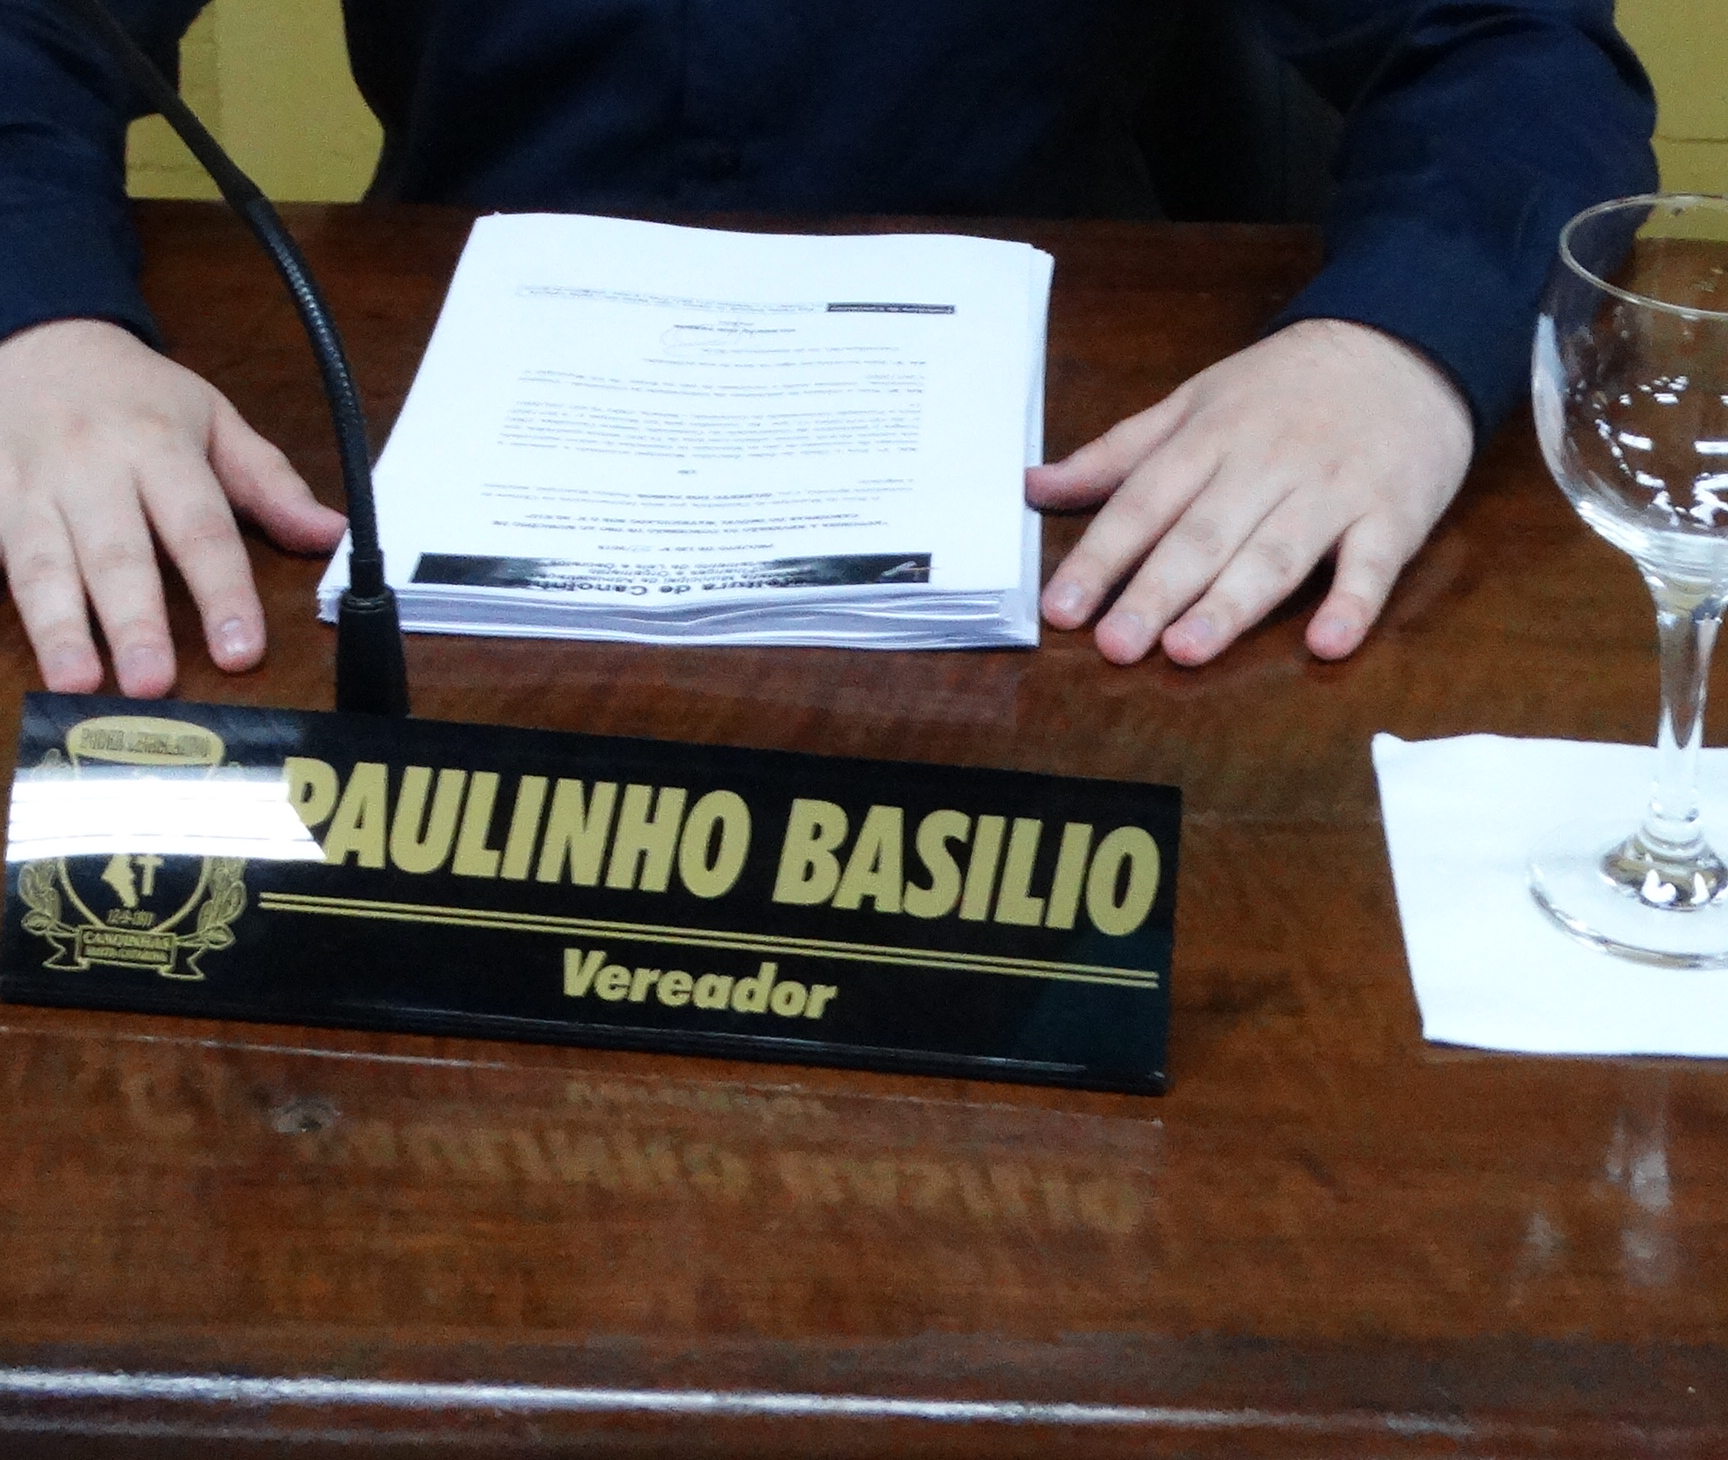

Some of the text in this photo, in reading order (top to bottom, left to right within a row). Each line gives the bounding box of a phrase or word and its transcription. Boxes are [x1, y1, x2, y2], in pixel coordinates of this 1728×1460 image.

[284, 755, 1161, 937] PAULINHO BASILIO
[562, 948, 838, 1020] Vereador
